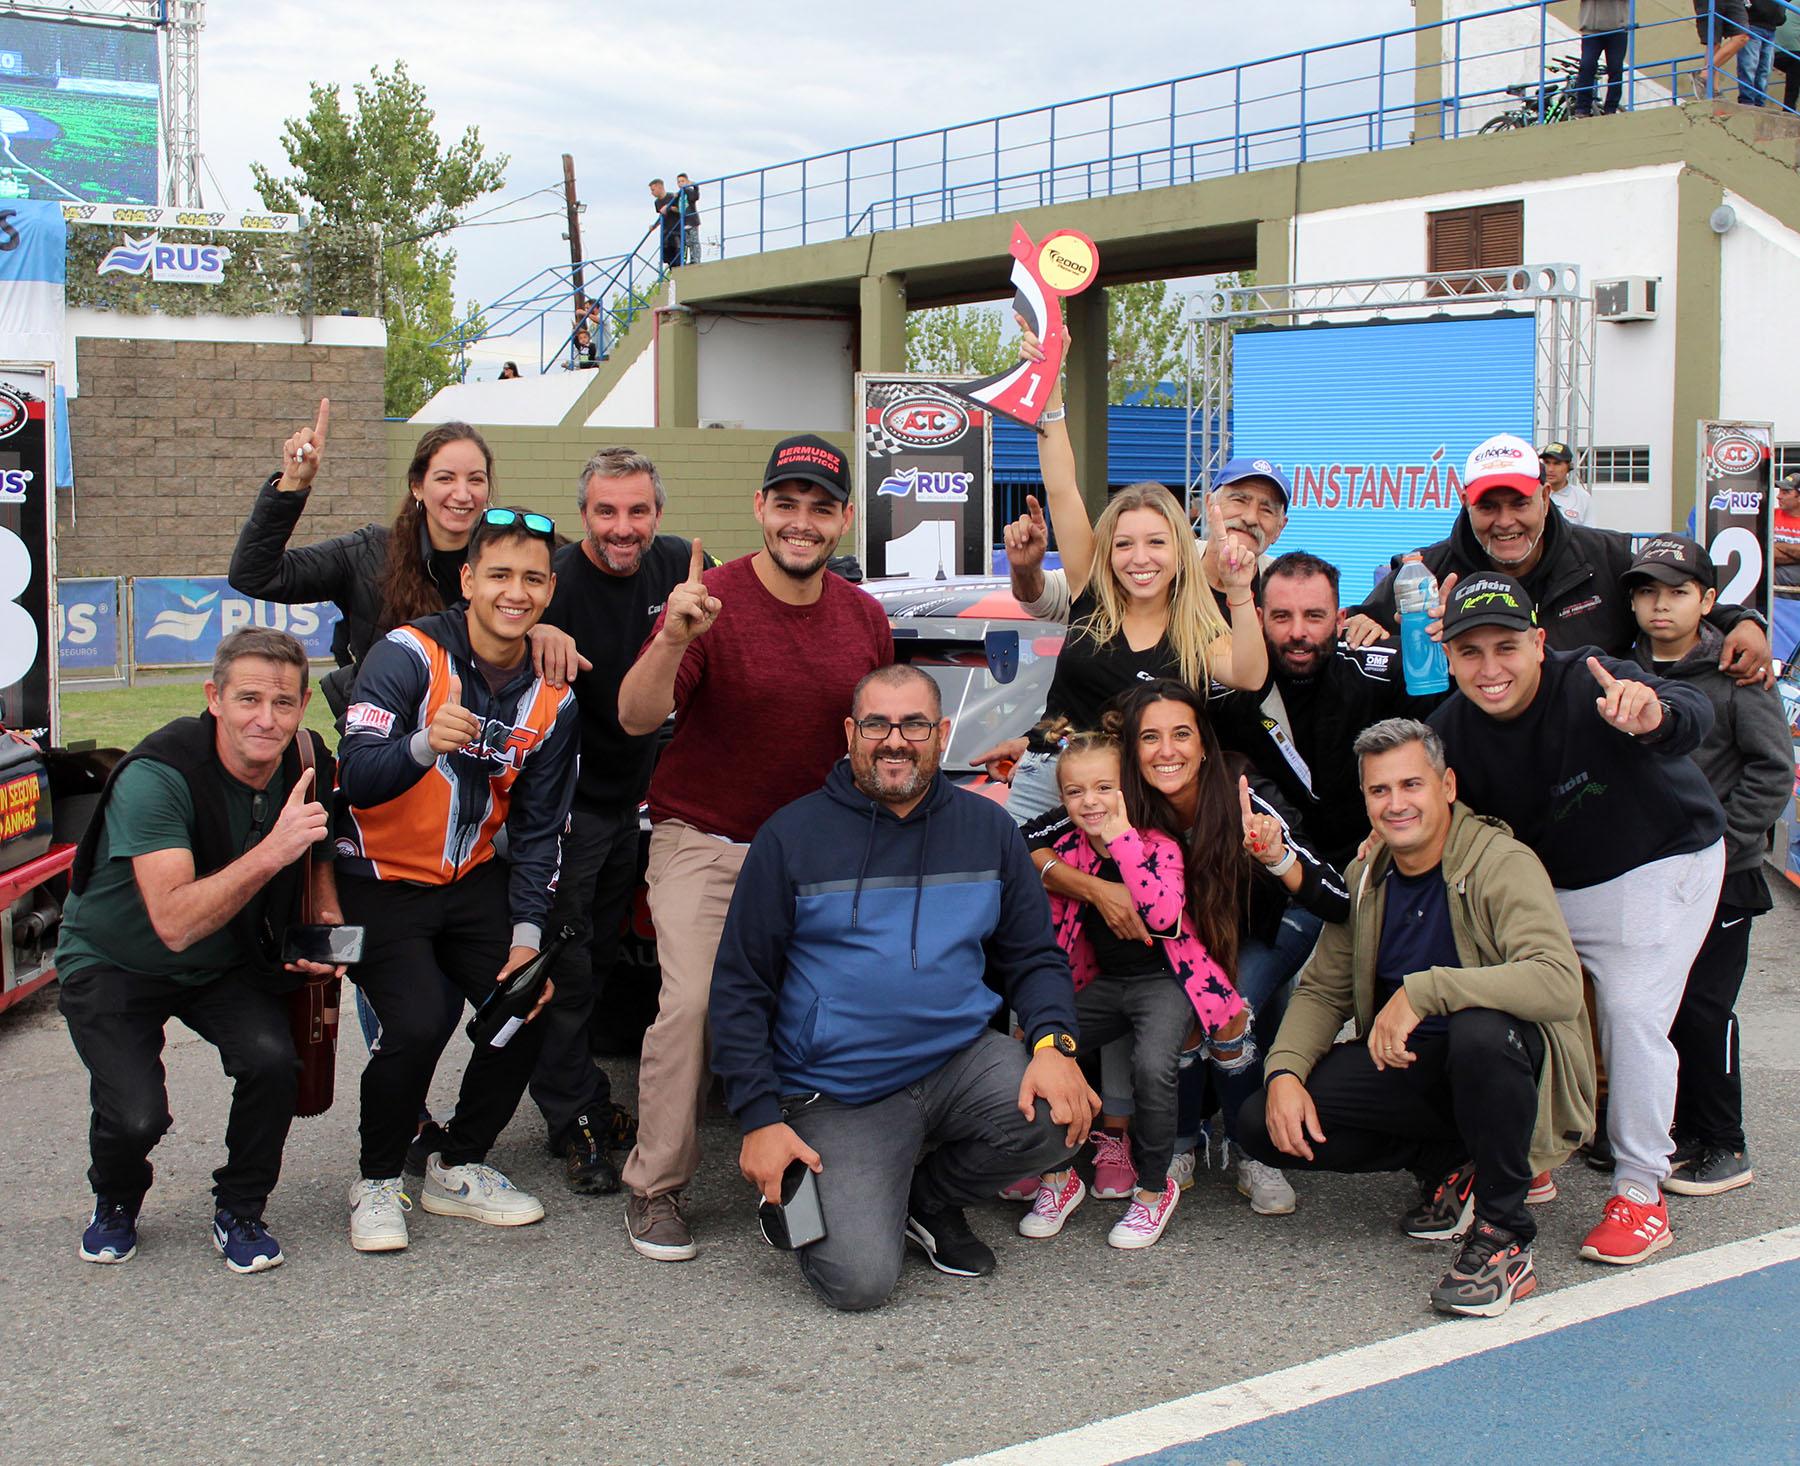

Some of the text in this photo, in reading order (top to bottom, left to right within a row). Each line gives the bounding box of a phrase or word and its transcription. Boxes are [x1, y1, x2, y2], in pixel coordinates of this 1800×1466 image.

[156, 246, 219, 272] RUS
[1020, 373, 1042, 408] 1
[779, 446, 840, 466] BERMUDEZ
[917, 474, 967, 494] RUS
[1731, 494, 1759, 508] RUS
[1366, 656, 1389, 665] OMP
